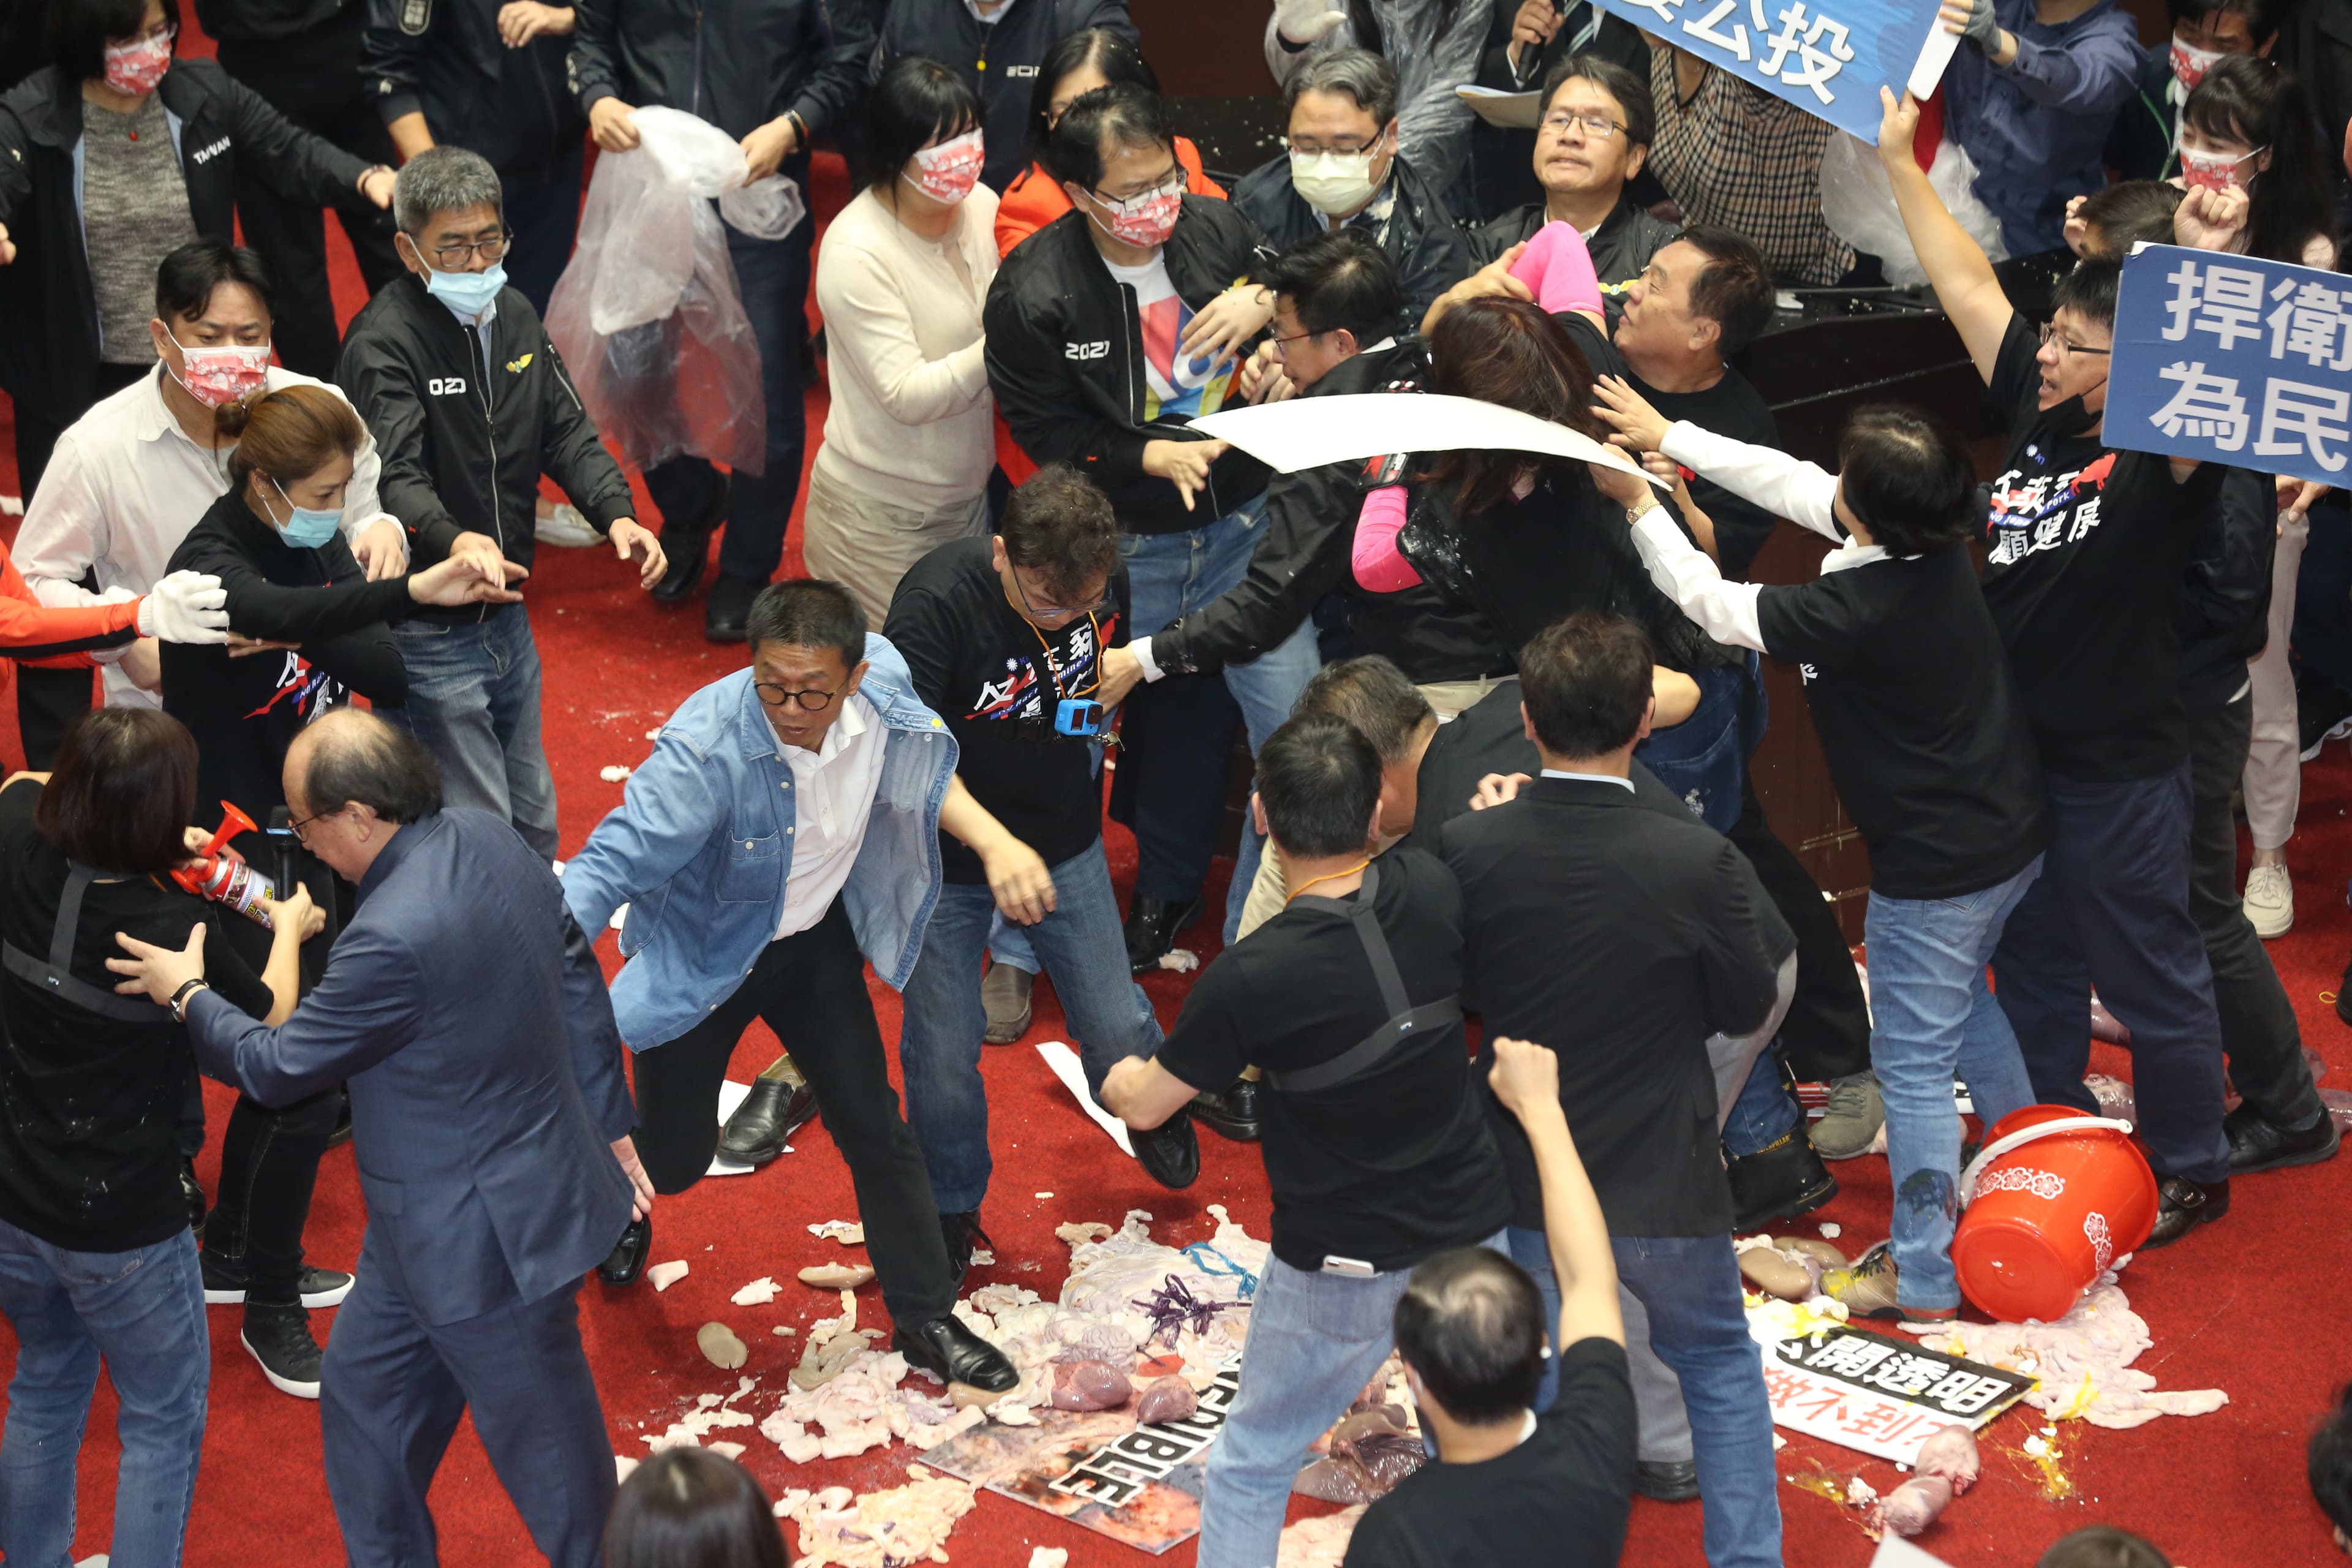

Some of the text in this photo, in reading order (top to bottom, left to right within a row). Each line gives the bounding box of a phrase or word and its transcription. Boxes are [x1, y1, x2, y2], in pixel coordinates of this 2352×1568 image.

[2161, 260, 2352, 372] 捍衛
[2149, 360, 2351, 472] 為民
[2046, 490, 2070, 507] Pork
